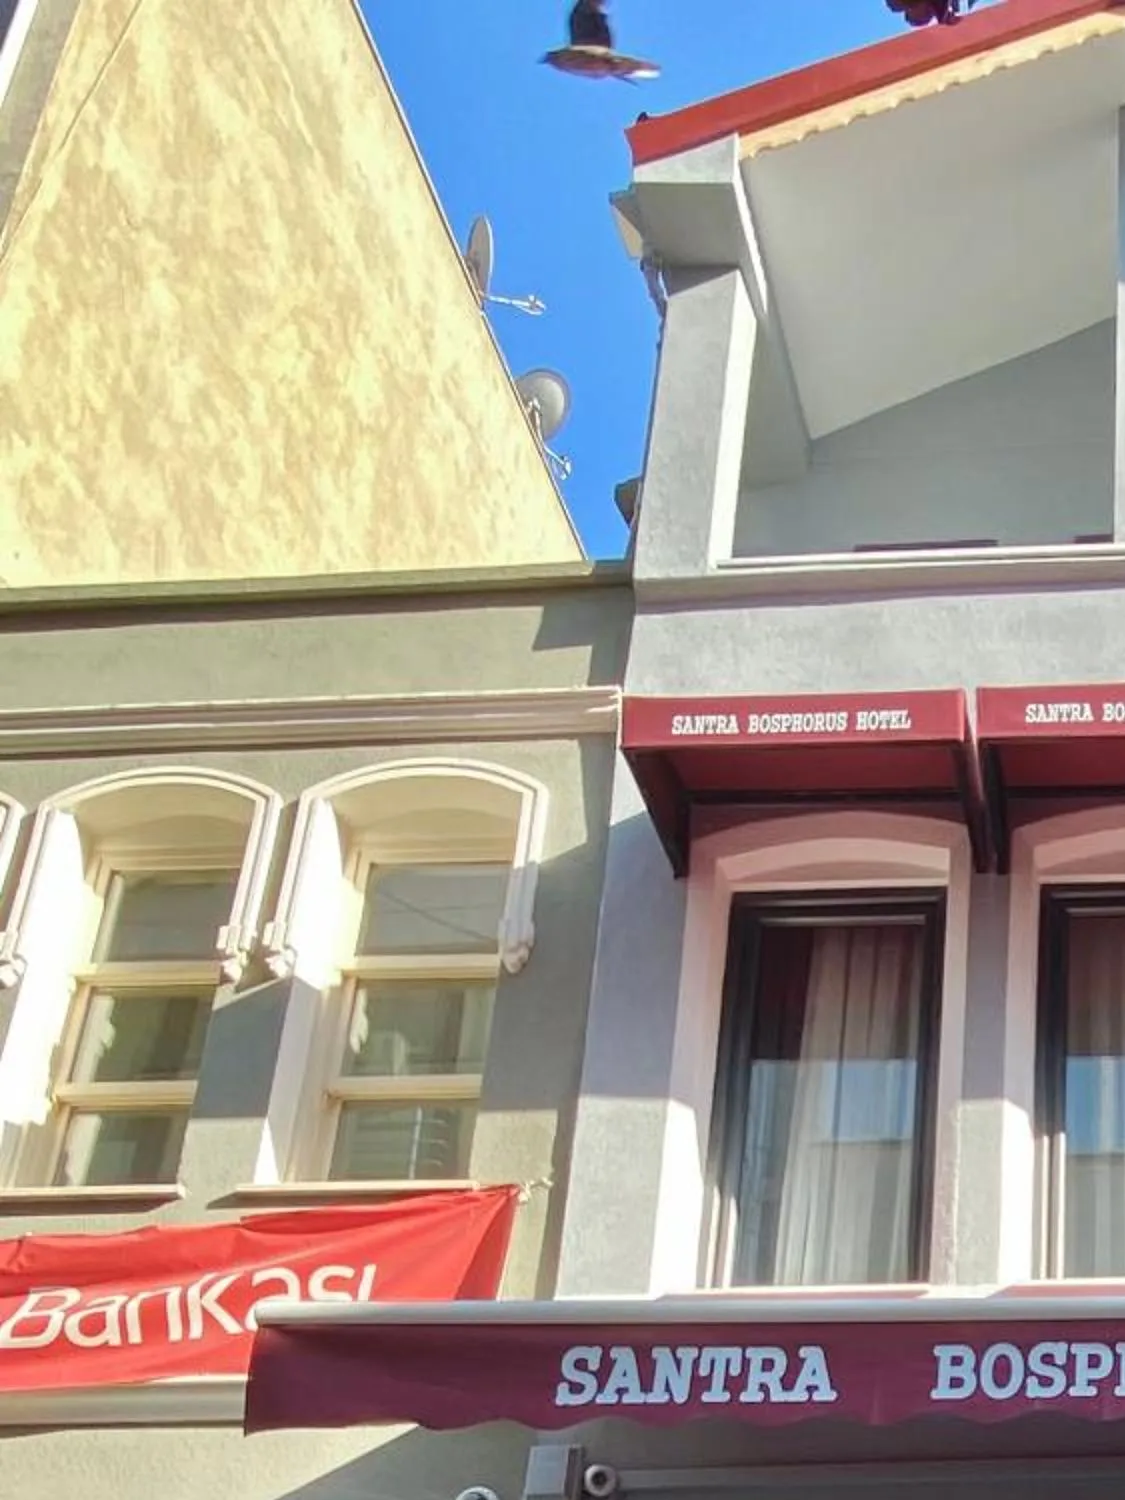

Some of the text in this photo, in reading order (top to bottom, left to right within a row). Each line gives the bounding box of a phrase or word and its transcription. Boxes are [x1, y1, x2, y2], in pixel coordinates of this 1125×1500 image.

[671, 709, 912, 736] SANTRA BOSPHORUS HOTEL
[1024, 703, 1094, 723] SANTRA
[555, 1344, 839, 1407] SANTRA
